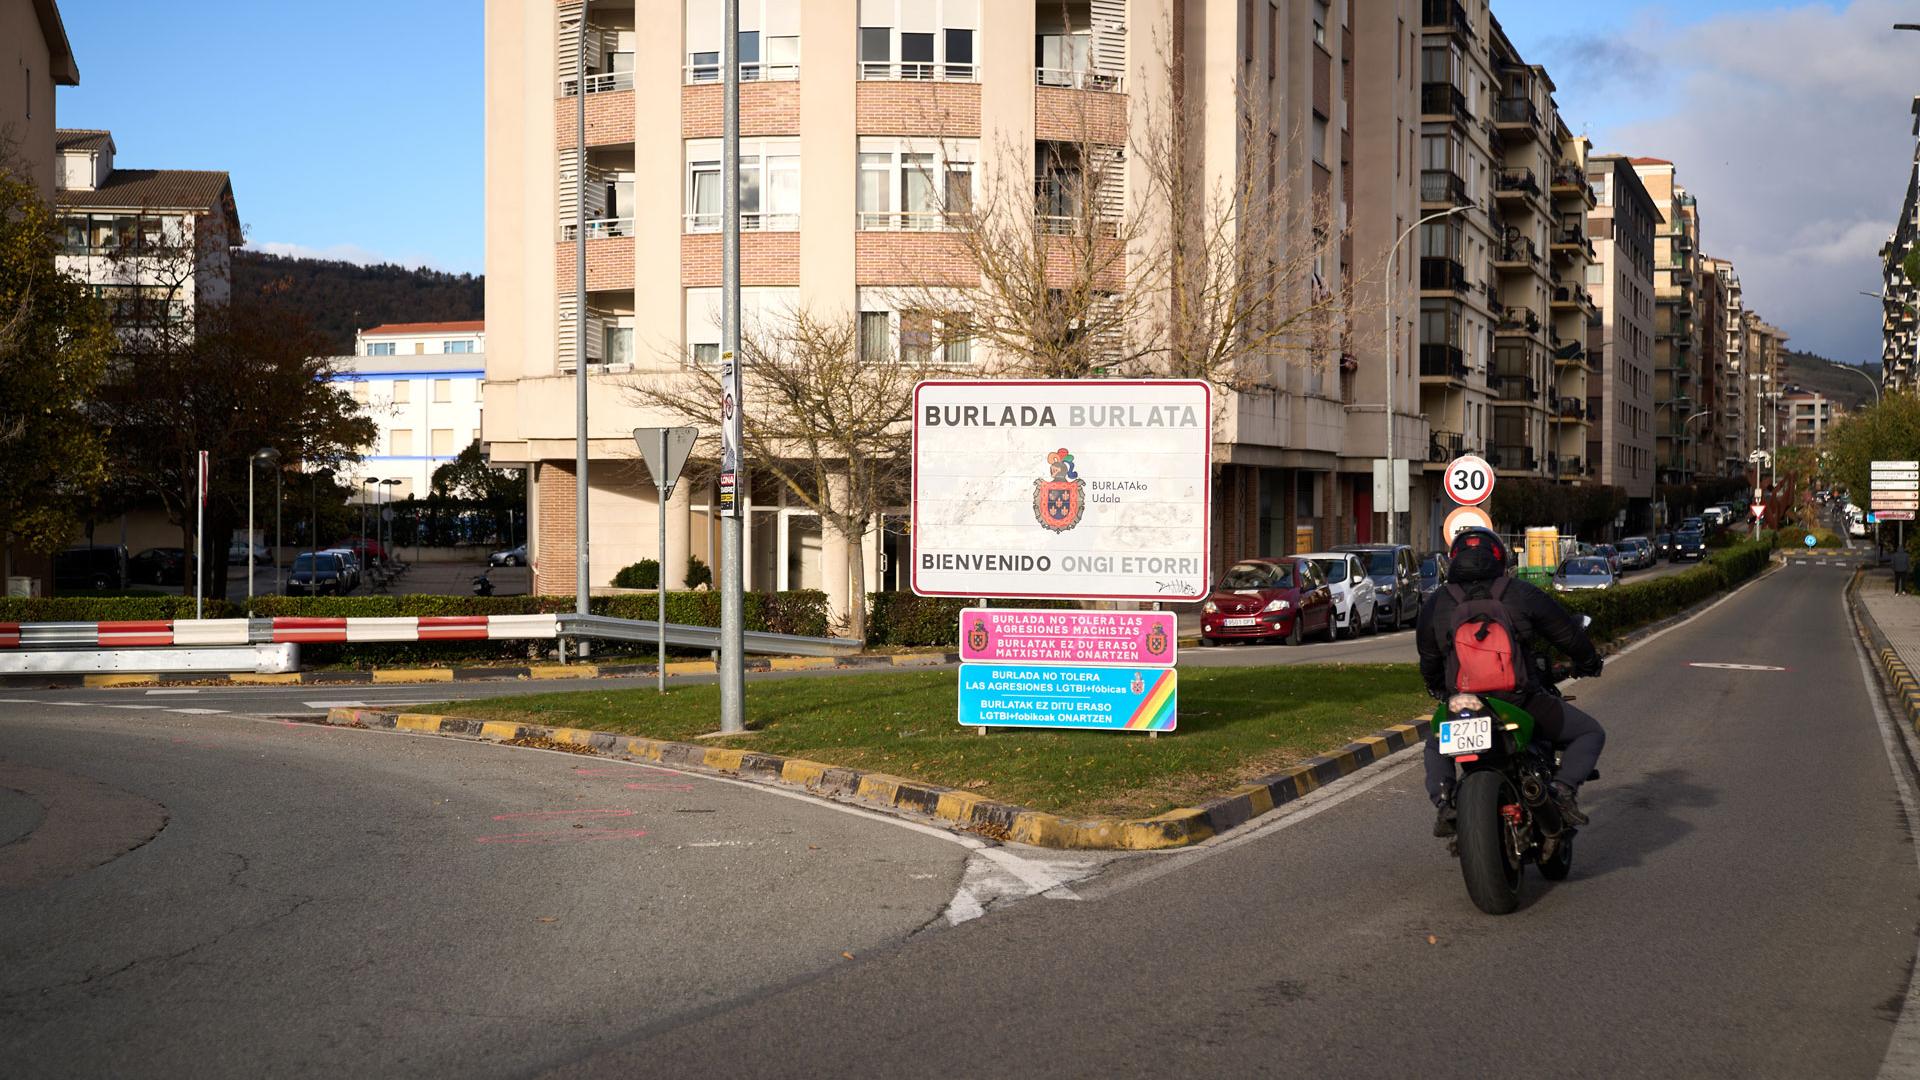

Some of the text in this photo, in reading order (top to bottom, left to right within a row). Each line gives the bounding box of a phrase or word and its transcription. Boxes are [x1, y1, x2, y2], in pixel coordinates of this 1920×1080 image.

[926, 406, 1198, 427] BURLADA BURLATA
[1454, 470, 1485, 490] 30
[1092, 481, 1147, 491] BURLATAko
[1092, 493, 1120, 503] Udala
[922, 554, 1198, 573] BIENVENIDO ONGI ETORRI
[993, 615, 1142, 626] BURLADA NO TOLERA LAS
[995, 625, 1140, 635] AGRESIONES MACHISTAS
[998, 639, 1137, 650] BURLATAK EZ DU ERASO
[996, 649, 1139, 660] MATXISTARIK ONARTZEN
[992, 671, 1100, 681] BURLADA NO TOLERA
[966, 682, 1127, 694] LAS AGRESIONES LGTBI+fóbicas
[981, 700, 1111, 711] BURLATAK EZ DITU ERASO
[980, 711, 1112, 723] LGTBI+fobikoak ONARTZEN
[1453, 720, 1488, 736] 2710
[1457, 735, 1484, 749] GNG
